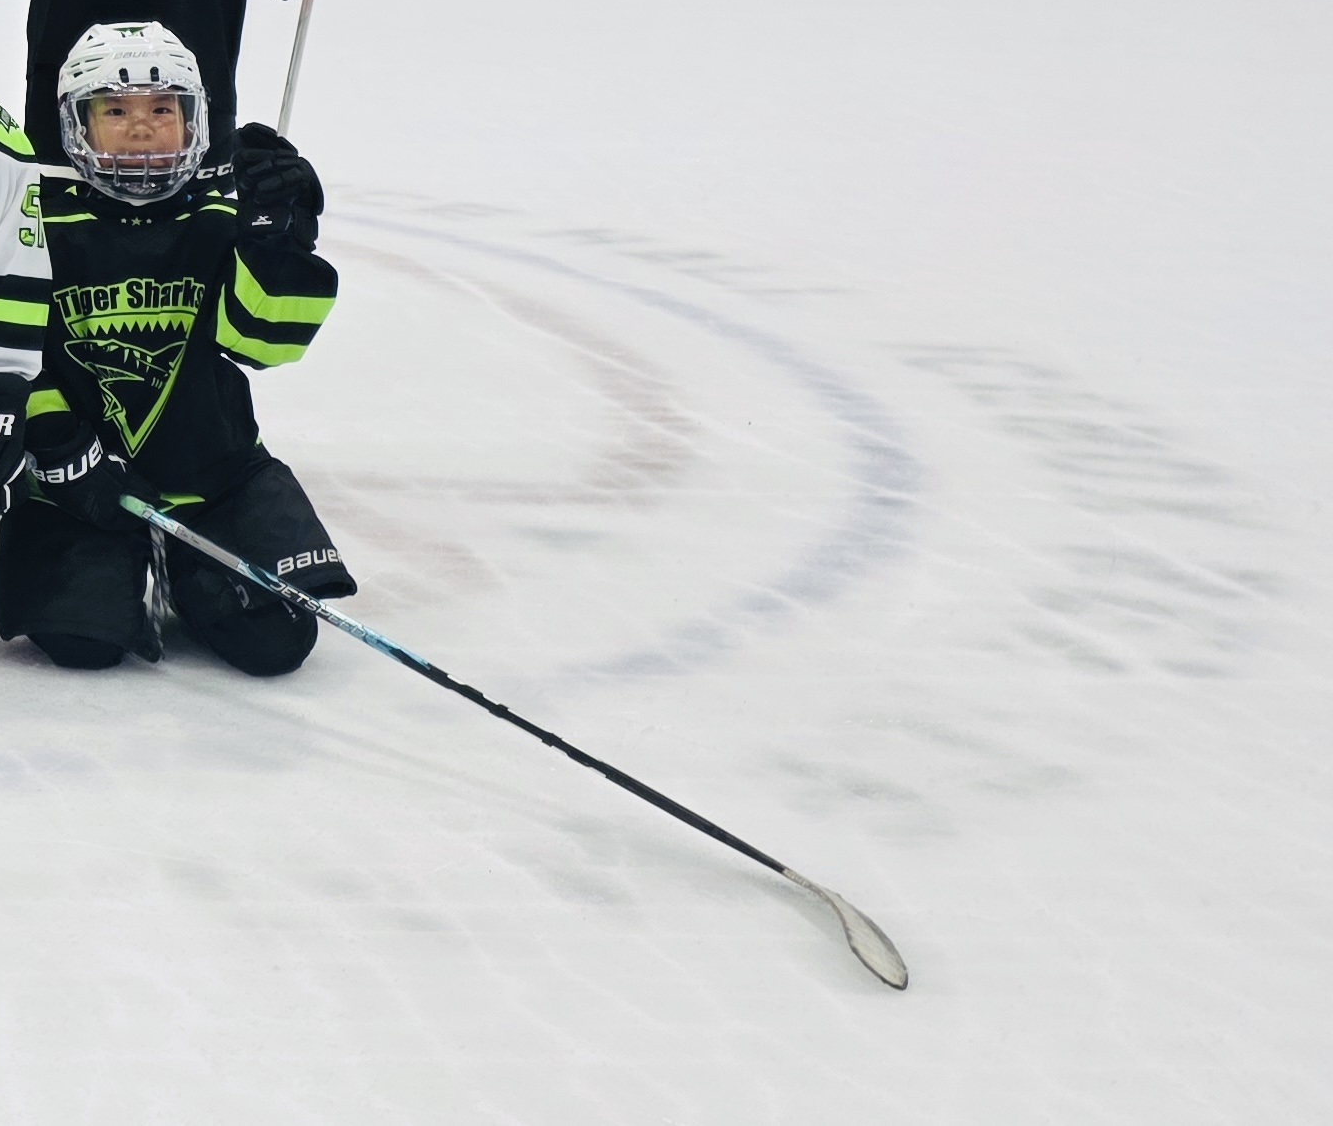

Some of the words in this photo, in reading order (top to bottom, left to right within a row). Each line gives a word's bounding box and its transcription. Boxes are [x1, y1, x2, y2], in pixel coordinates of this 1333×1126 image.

[52, 285, 121, 320] Tiger
[125, 279, 206, 311] Sharks
[33, 435, 102, 484] BAUE
[276, 547, 346, 578] BAUE
